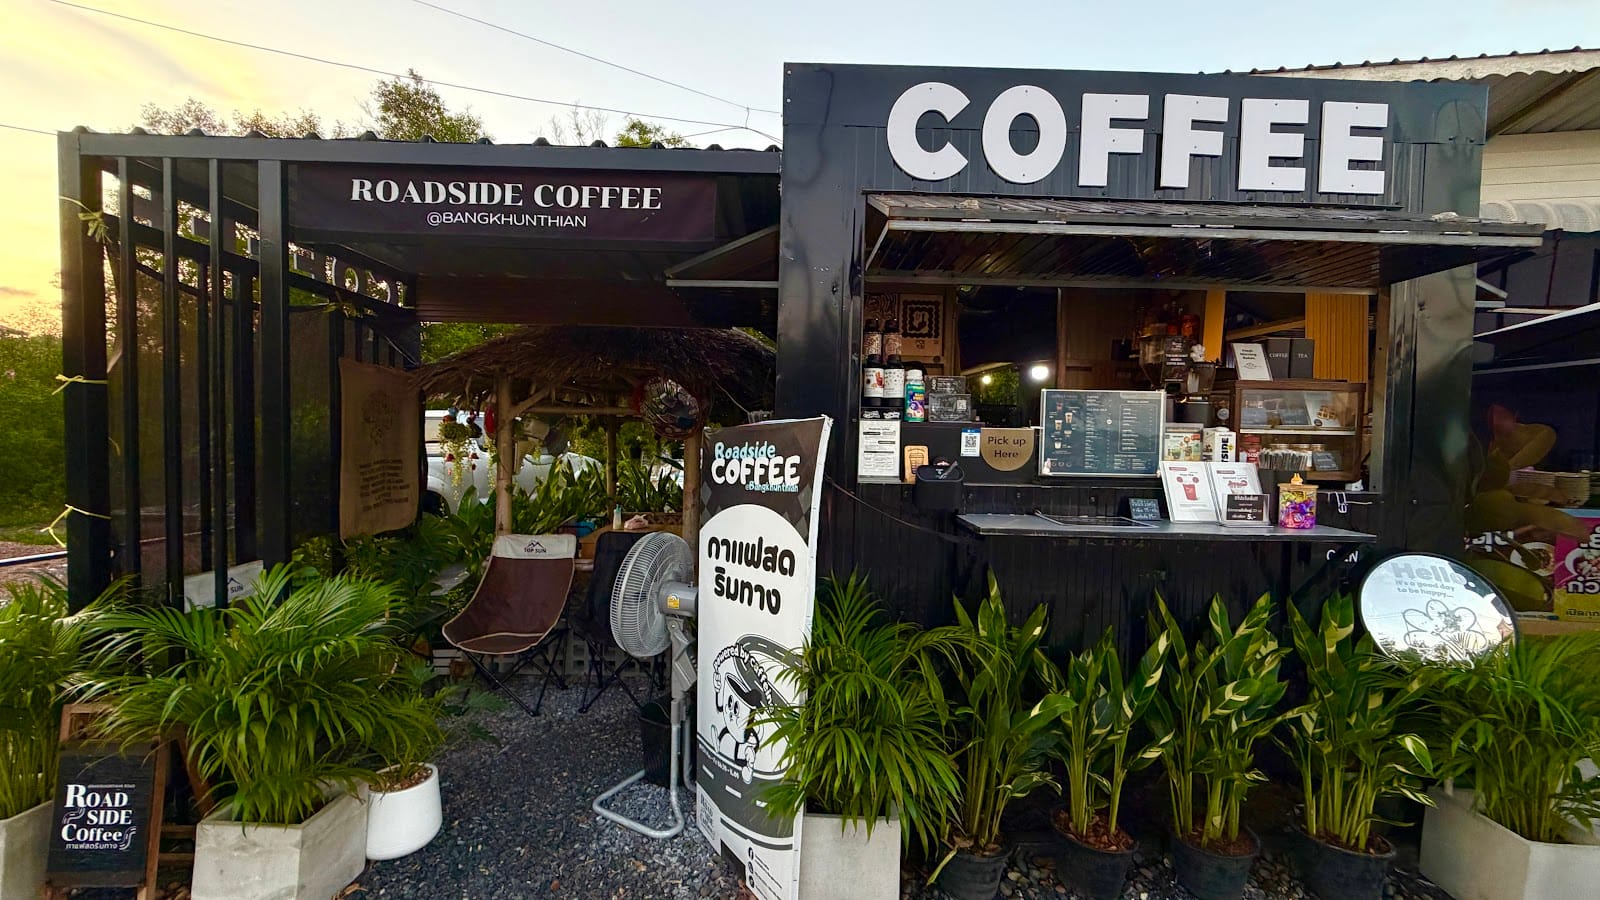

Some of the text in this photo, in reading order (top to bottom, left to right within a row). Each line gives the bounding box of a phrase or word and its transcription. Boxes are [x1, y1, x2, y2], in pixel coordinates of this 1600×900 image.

[886, 81, 1390, 195] COFFEE
[350, 178, 662, 210] ROADSIDE COFFEE
[426, 211, 587, 228] @BANGKHUNTHIAN
[714, 440, 776, 459] Roadside
[987, 436, 1026, 447] Pick up
[994, 450, 1019, 458] Here
[711, 455, 800, 485] COFFEE
[708, 536, 796, 577] กาแฟสด
[230, 585, 244, 593] SUN
[714, 566, 781, 615] ริมทาง
[1440, 583, 1455, 592] day
[713, 645, 739, 672] powered
[740, 645, 750, 664] by
[86, 809, 133, 825] SIDE
[61, 823, 123, 842] Coffee
